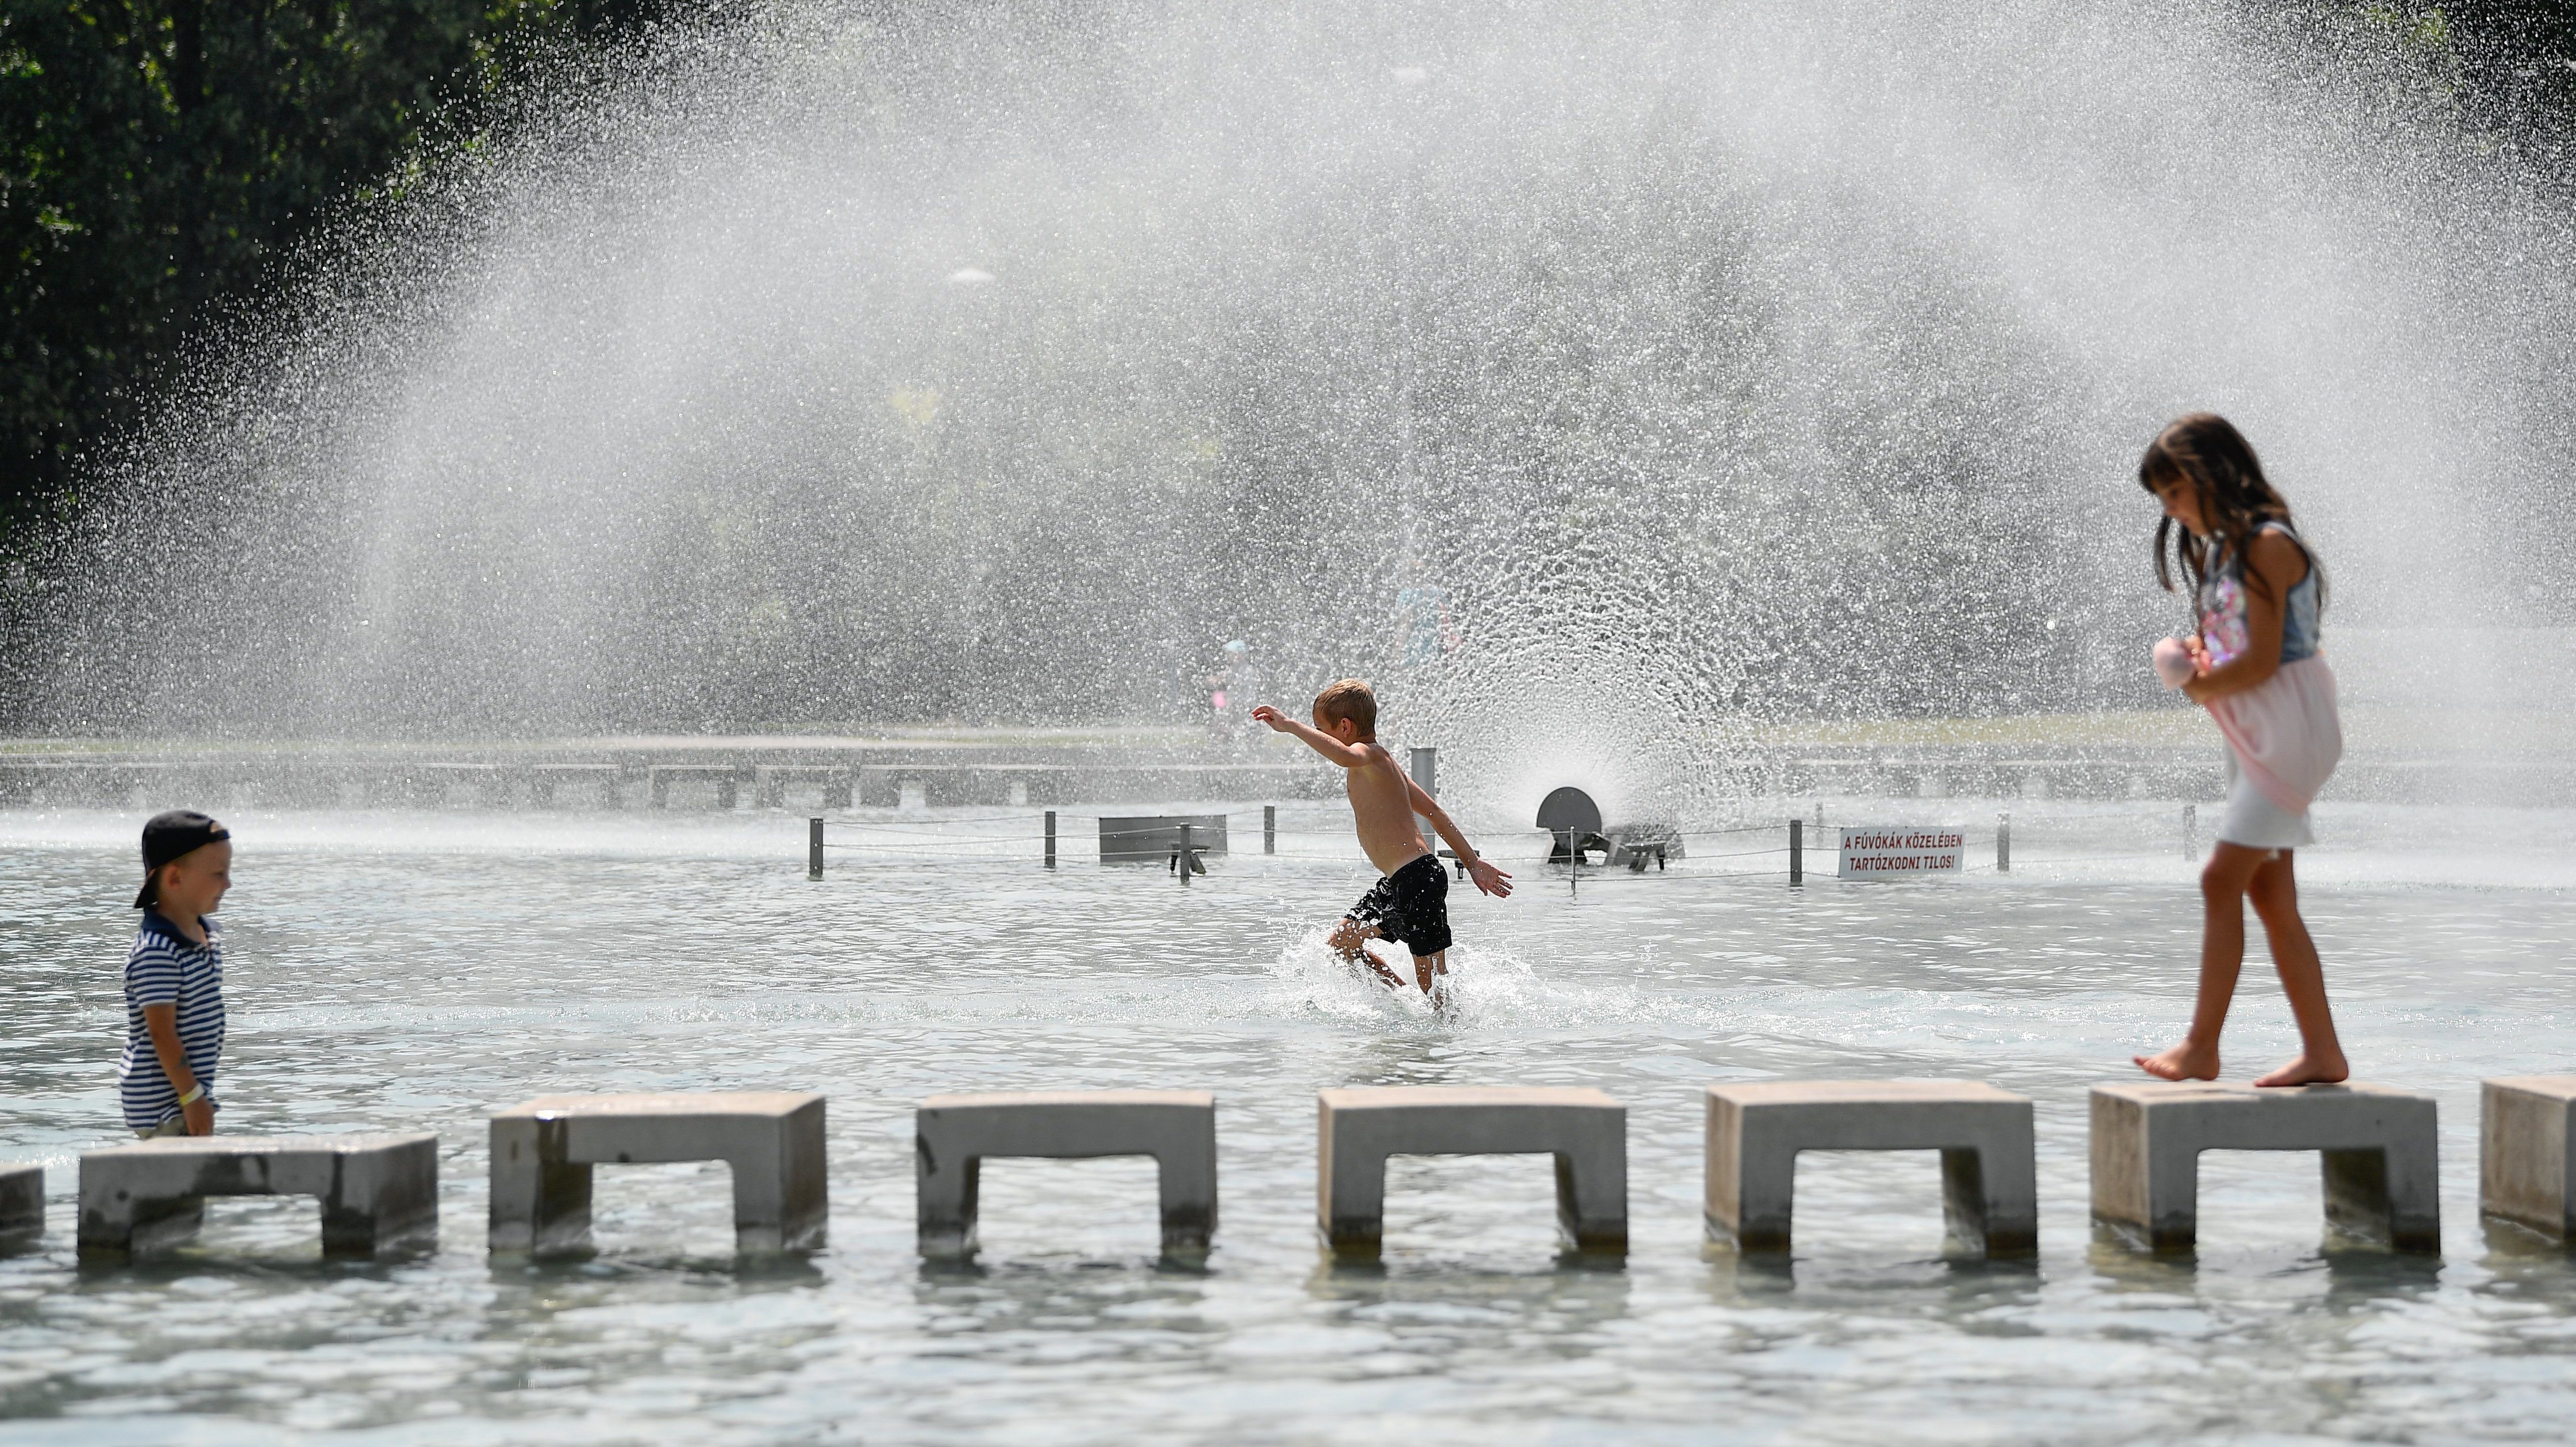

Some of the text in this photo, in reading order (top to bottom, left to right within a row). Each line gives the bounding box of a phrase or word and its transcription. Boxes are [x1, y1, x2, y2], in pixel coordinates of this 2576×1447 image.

[1845, 831, 1962, 849] A FÚVÓKÁK KÖZELÉBEN
[1850, 853, 1955, 871] TARTÓZKODNI TILOS!
